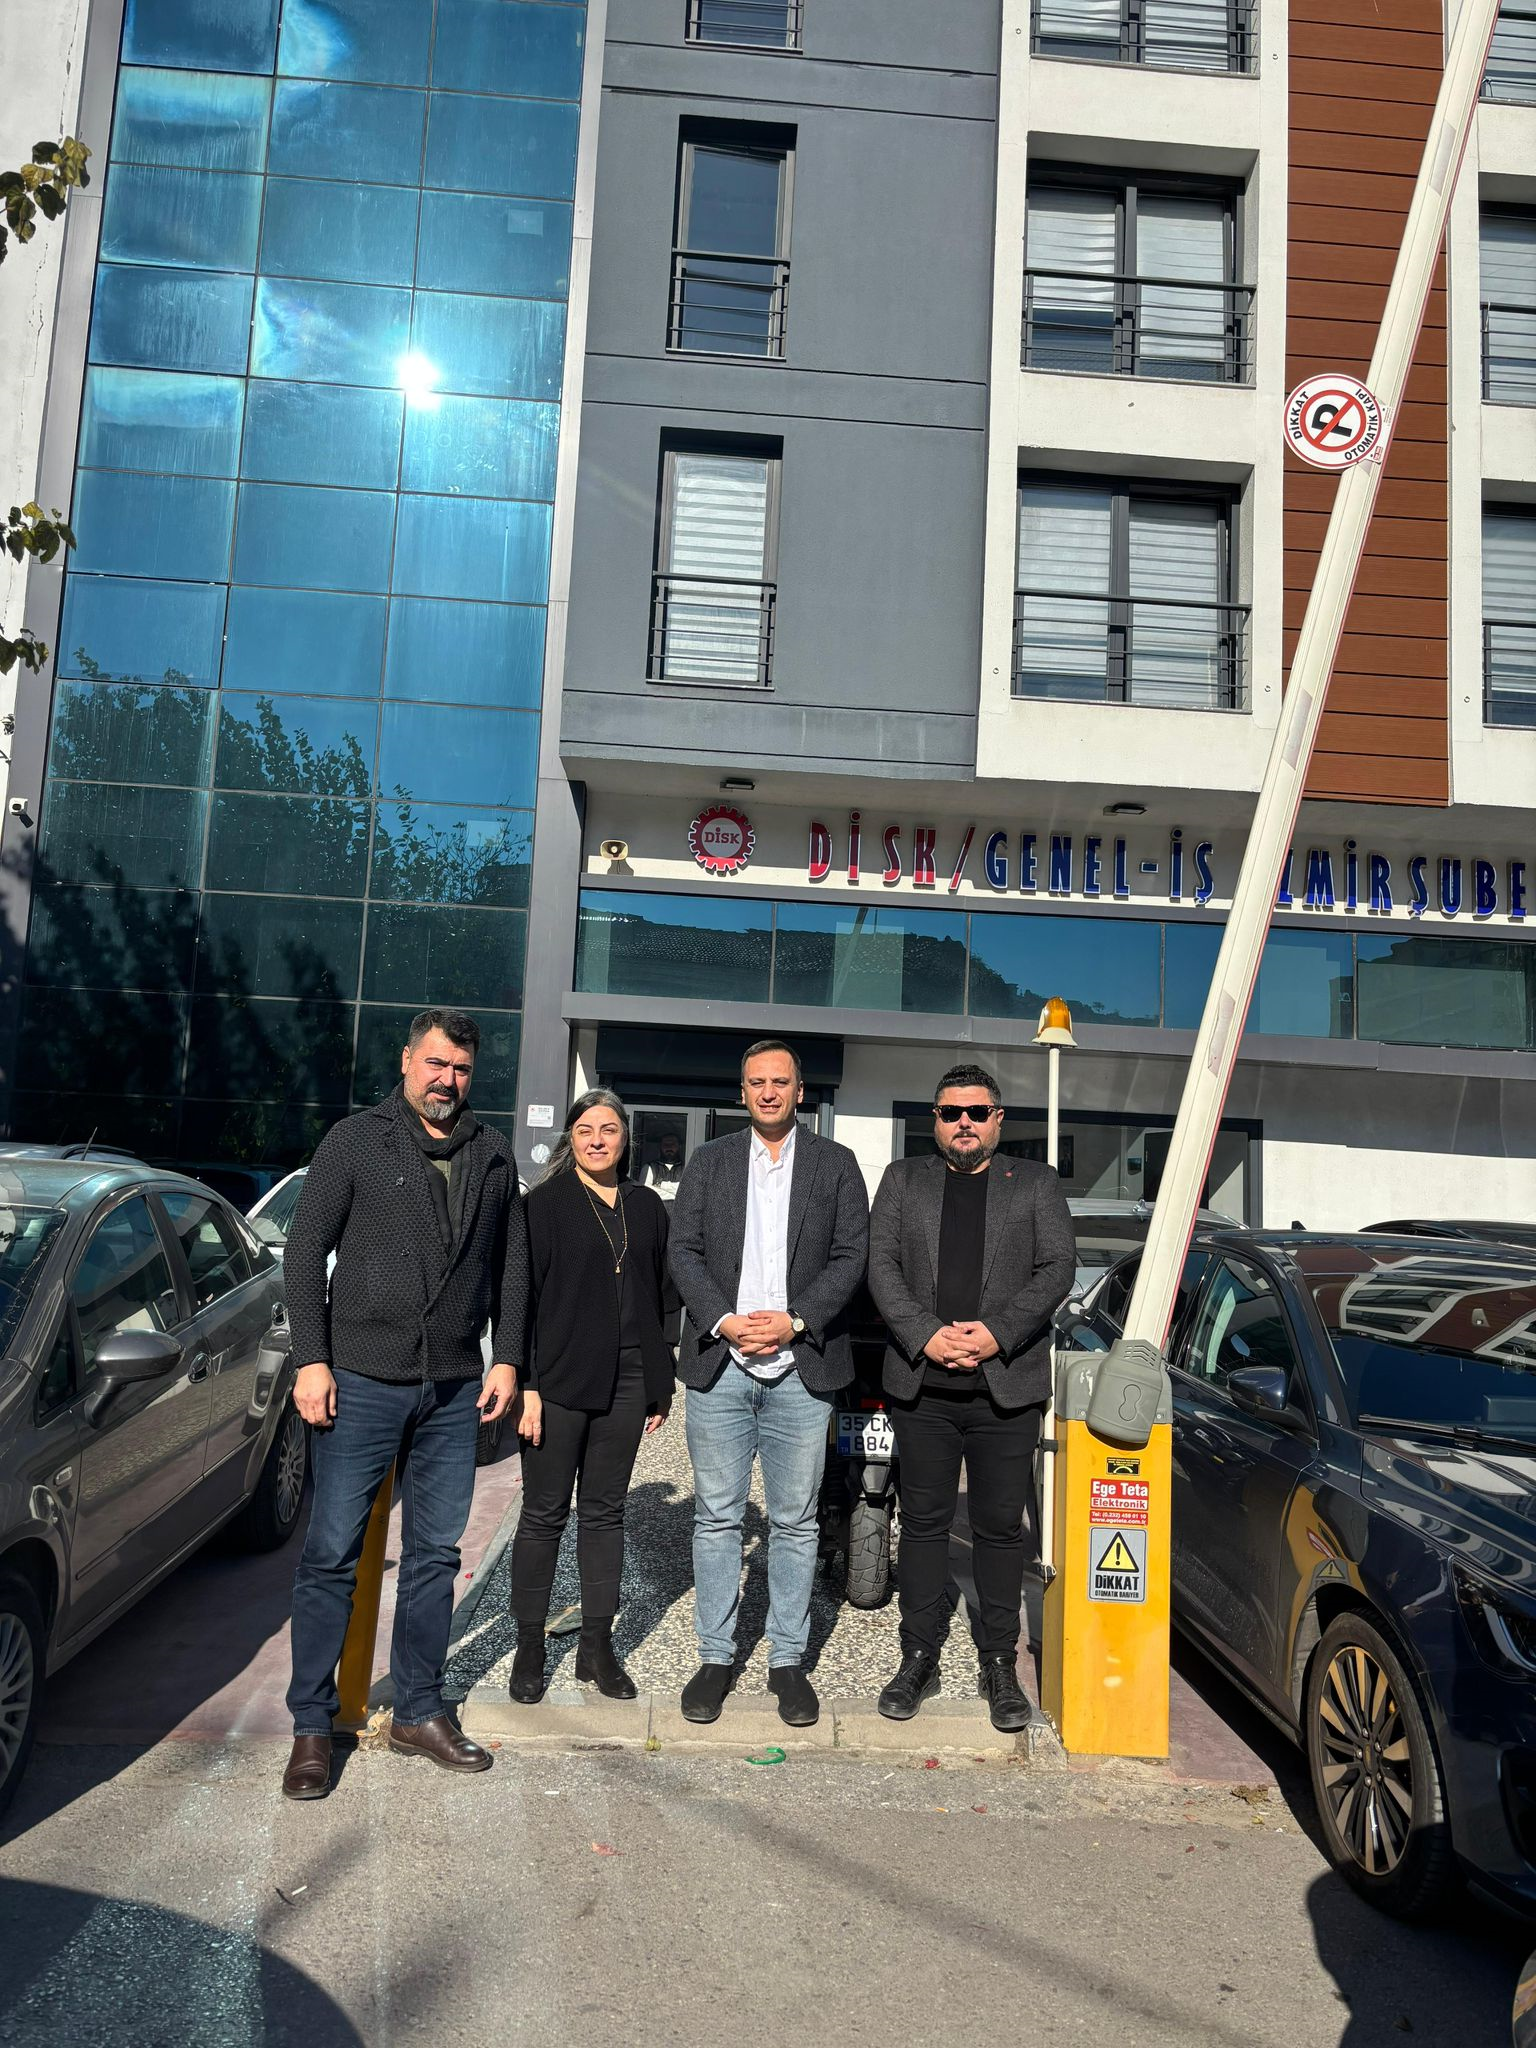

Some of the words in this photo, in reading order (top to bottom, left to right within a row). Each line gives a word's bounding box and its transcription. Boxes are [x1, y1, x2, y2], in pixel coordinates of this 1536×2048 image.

[1355, 388, 1376, 412] KAPI
[1289, 391, 1309, 440] DİKKAT
[1344, 414, 1378, 460] OTOMATİK
[704, 826, 740, 844] DİSK
[842, 1416, 864, 1432] 35
[870, 1417, 893, 1433] CK
[854, 1436, 890, 1452] 884
[1092, 1481, 1116, 1497] Ege
[1120, 1482, 1148, 1497] Teta
[1093, 1498, 1145, 1509] Elektronik
